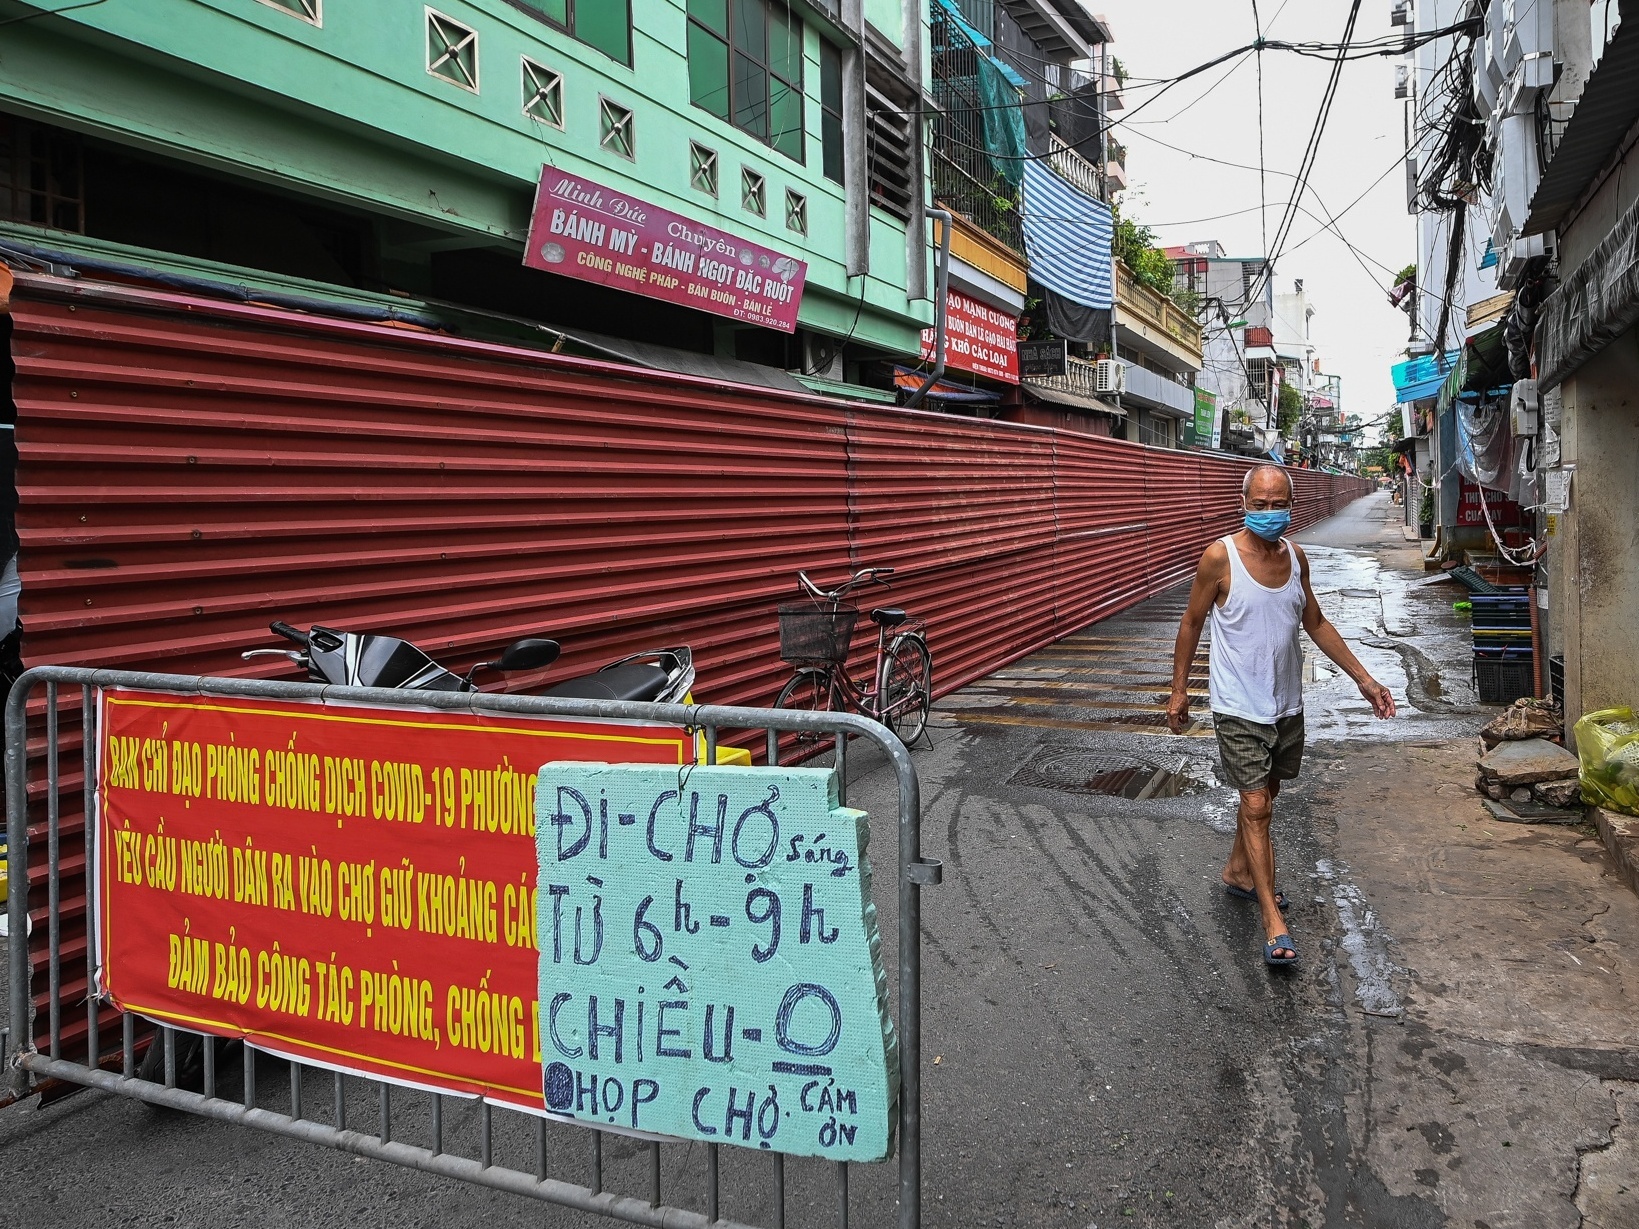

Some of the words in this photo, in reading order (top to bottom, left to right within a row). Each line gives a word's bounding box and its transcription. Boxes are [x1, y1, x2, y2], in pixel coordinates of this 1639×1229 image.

[548, 178, 603, 208] Minh
[608, 198, 647, 224] Đức
[550, 209, 605, 248] BÁNH
[610, 227, 638, 256] MỲ
[651, 241, 694, 274] BÁNH
[699, 260, 735, 290] NGỌT
[735, 268, 761, 296] ĐẶC
[764, 280, 794, 304] RUỘT
[667, 222, 736, 258] Chuyên
[577, 251, 612, 273] CÔNG
[615, 263, 648, 283] NGHỆ
[649, 272, 679, 290] PHÁP
[688, 282, 708, 300] BÁN
[710, 288, 736, 306] BUÔN
[743, 298, 761, 314] BÁN
[762, 302, 772, 316] LẺ
[734, 308, 746, 318] ĐT:
[946, 293, 961, 310] ẠO
[963, 298, 988, 318] MẠNH
[988, 310, 1015, 332] CƯỜNG
[950, 337, 970, 354] KHÔ
[972, 343, 988, 360] CÁC
[990, 350, 1008, 368] LOẠI
[110, 736, 140, 788] BAN
[142, 721, 168, 793] CHỈ
[172, 740, 202, 808] ĐẠO
[206, 732, 260, 805] PHÒNG
[264, 731, 320, 812] CHỐNG
[324, 756, 366, 828] DỊCH
[371, 760, 455, 828] COVID-19
[114, 820, 142, 886] YÊU
[144, 817, 177, 892] CẦU
[180, 830, 230, 900] NGƯỜI
[233, 839, 268, 906] DÂN
[272, 852, 296, 912] RA
[298, 844, 332, 918] VÀO
[337, 859, 376, 938] CHỢ
[380, 857, 414, 930] GIỮ
[418, 856, 498, 944] KHOẢNG
[548, 875, 604, 965] TỪ
[168, 918, 210, 996] ĐẢM
[214, 926, 252, 1006] BẢO
[256, 943, 310, 1017] CÔNG
[316, 951, 354, 1027] TÁC
[360, 960, 440, 1050] PHÒNG,
[446, 969, 524, 1060] CHỐNG
